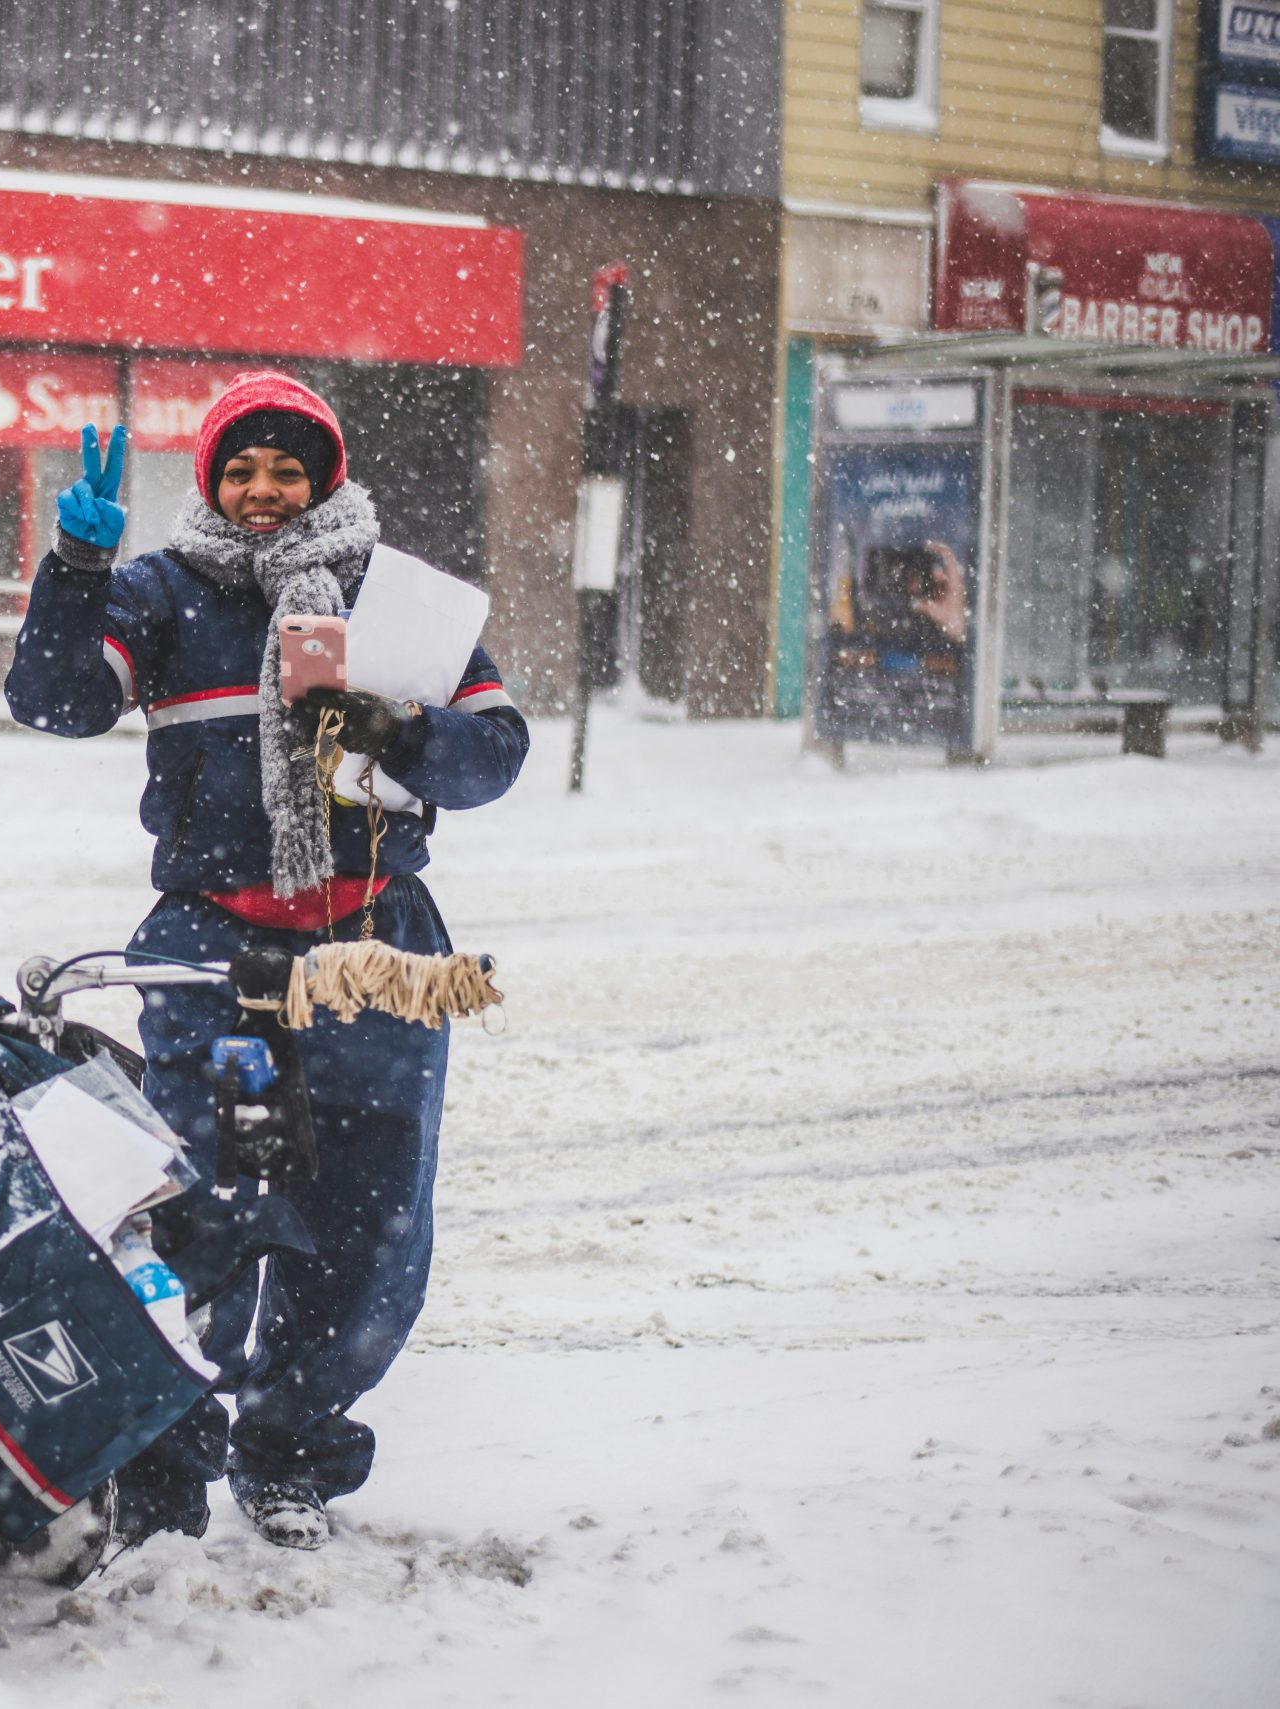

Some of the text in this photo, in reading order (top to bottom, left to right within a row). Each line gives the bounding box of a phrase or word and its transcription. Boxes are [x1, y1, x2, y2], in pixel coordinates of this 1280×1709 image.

[1063, 298, 1263, 353] BARBER SHOP
[13, 1376, 36, 1404] STATES
